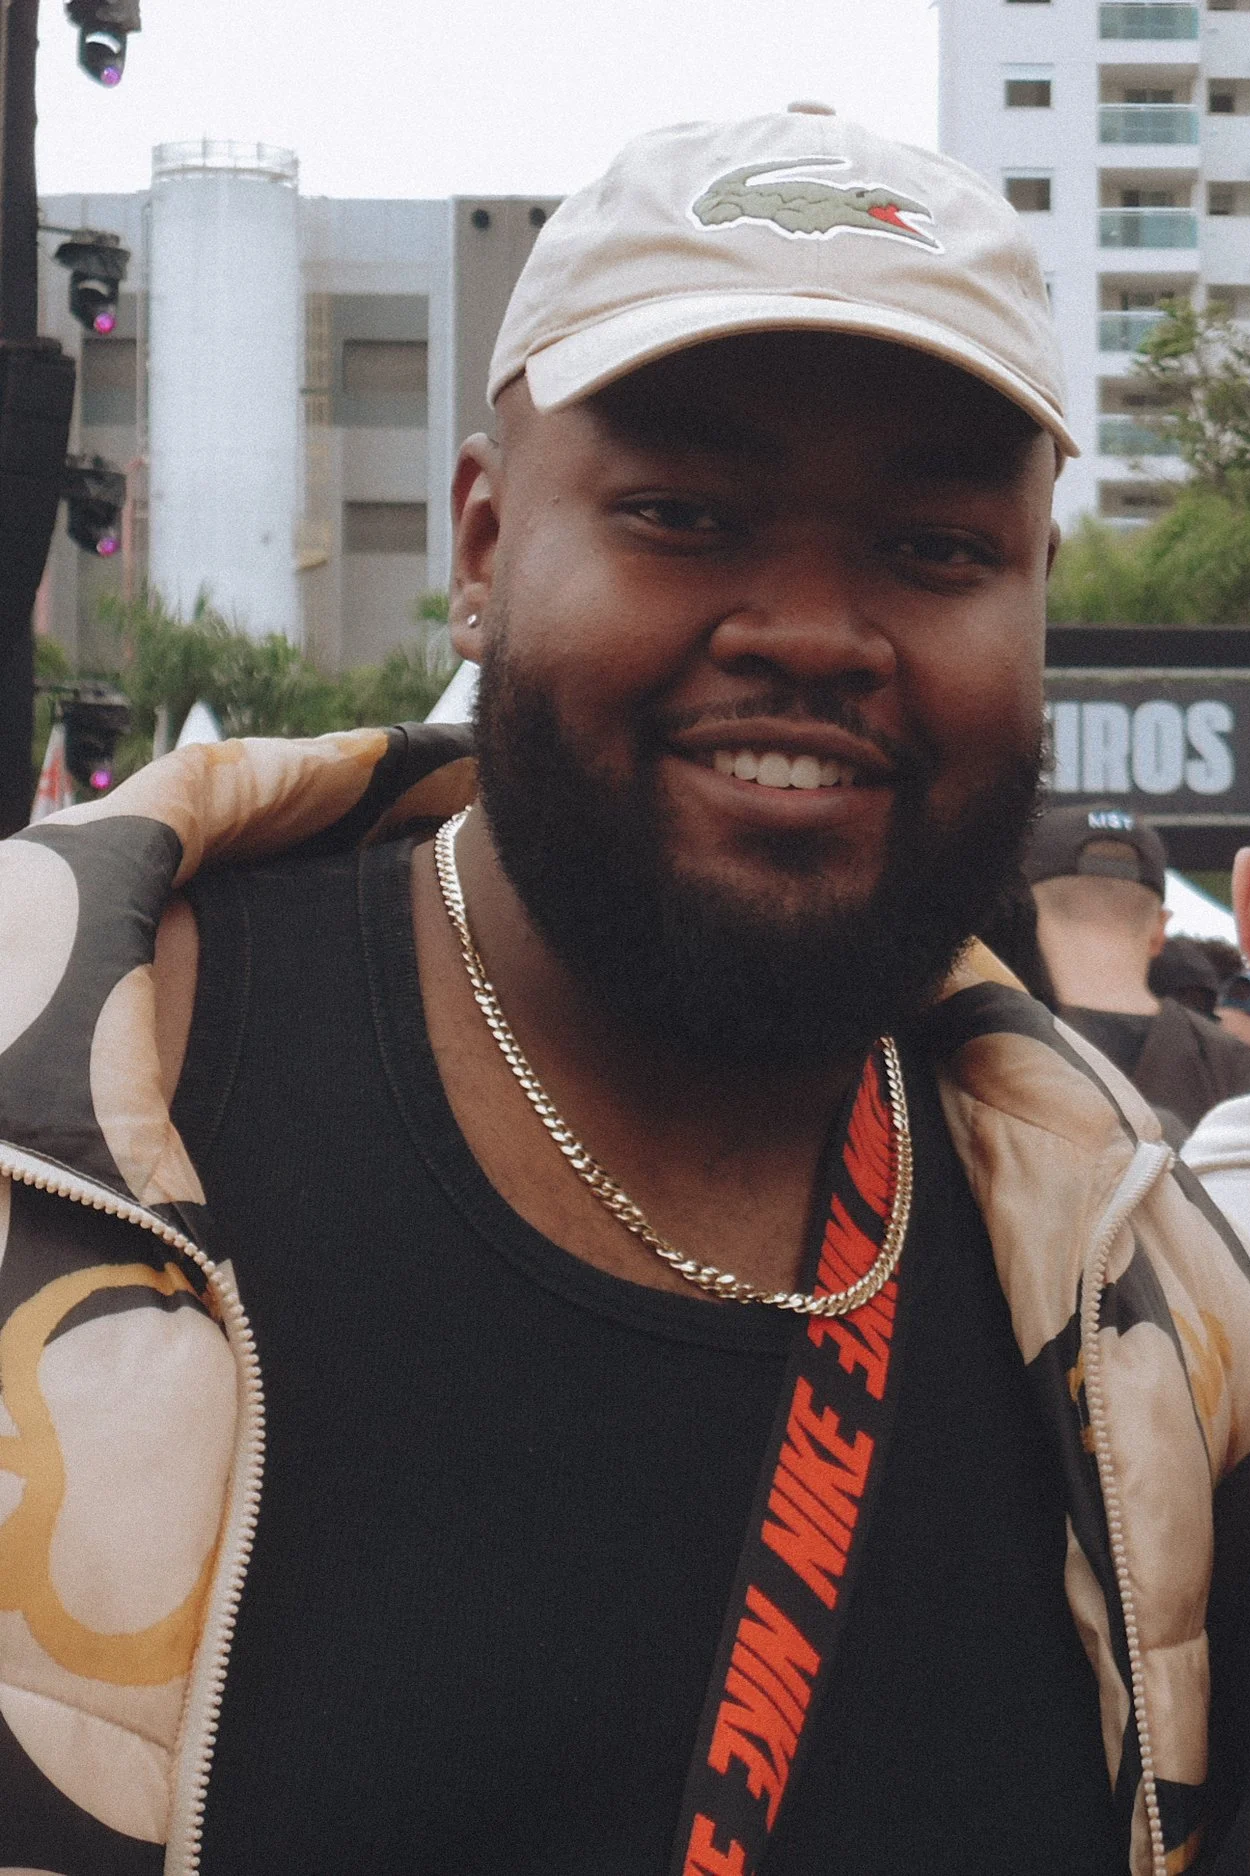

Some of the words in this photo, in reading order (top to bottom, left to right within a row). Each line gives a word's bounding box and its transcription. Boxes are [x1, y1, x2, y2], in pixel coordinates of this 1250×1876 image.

[1040, 701, 1234, 794] IROS
[761, 1375, 874, 1611] NIKE
[707, 1583, 822, 1833] NIKE
